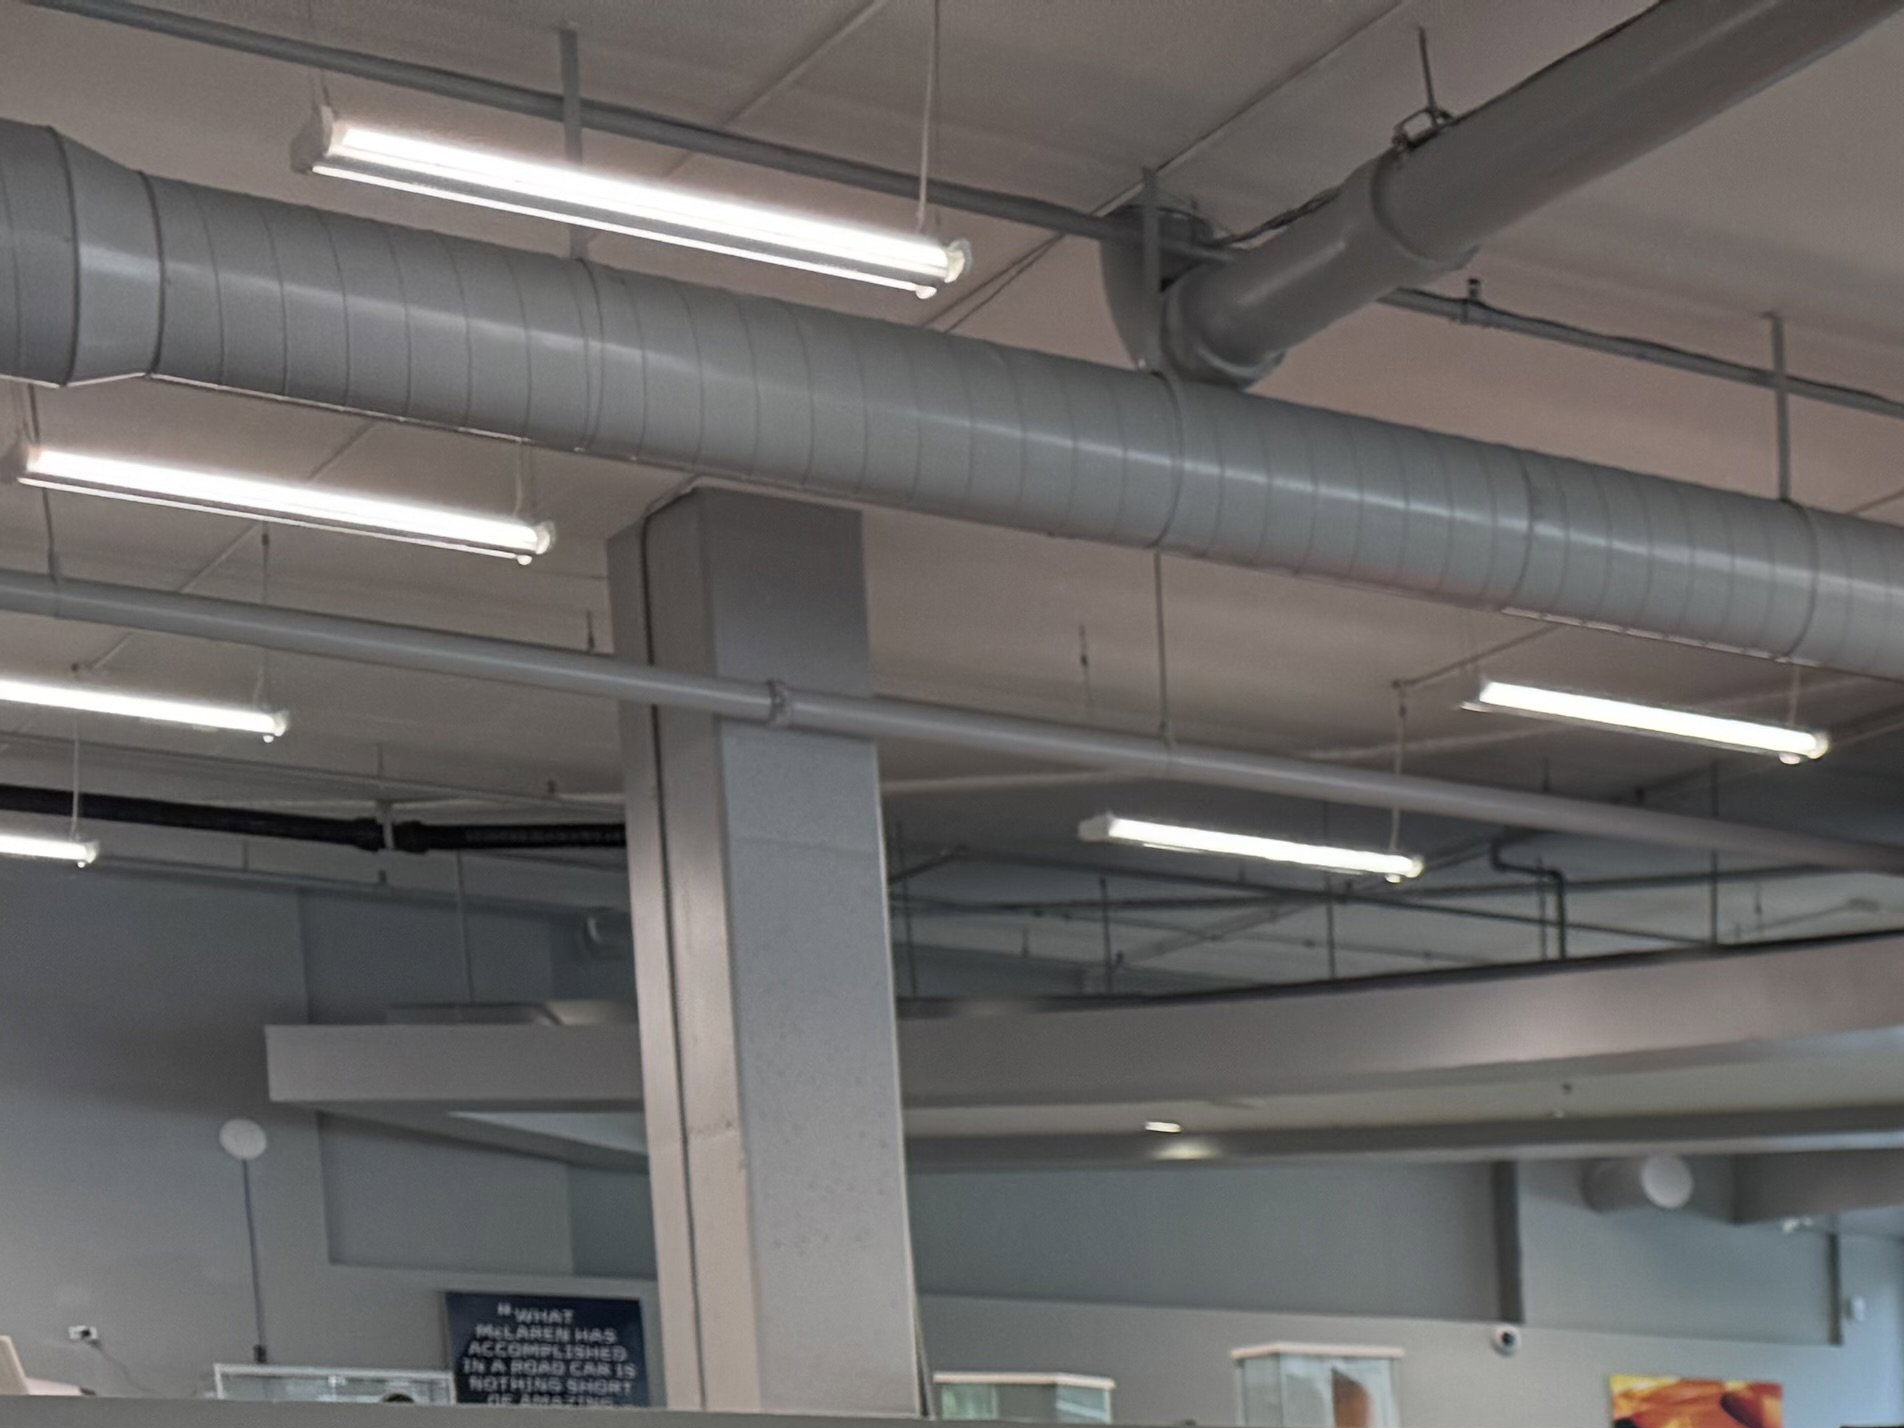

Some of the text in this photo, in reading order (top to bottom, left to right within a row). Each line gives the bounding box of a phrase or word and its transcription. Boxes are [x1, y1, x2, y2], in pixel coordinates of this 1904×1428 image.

[574, 1328, 618, 1345] HAS
[468, 1341, 629, 1363] ACCOMPLISHED
[462, 1356, 637, 1380] IN A ROAD CAR IS
[468, 1375, 633, 1396] NOTHING SHORT
